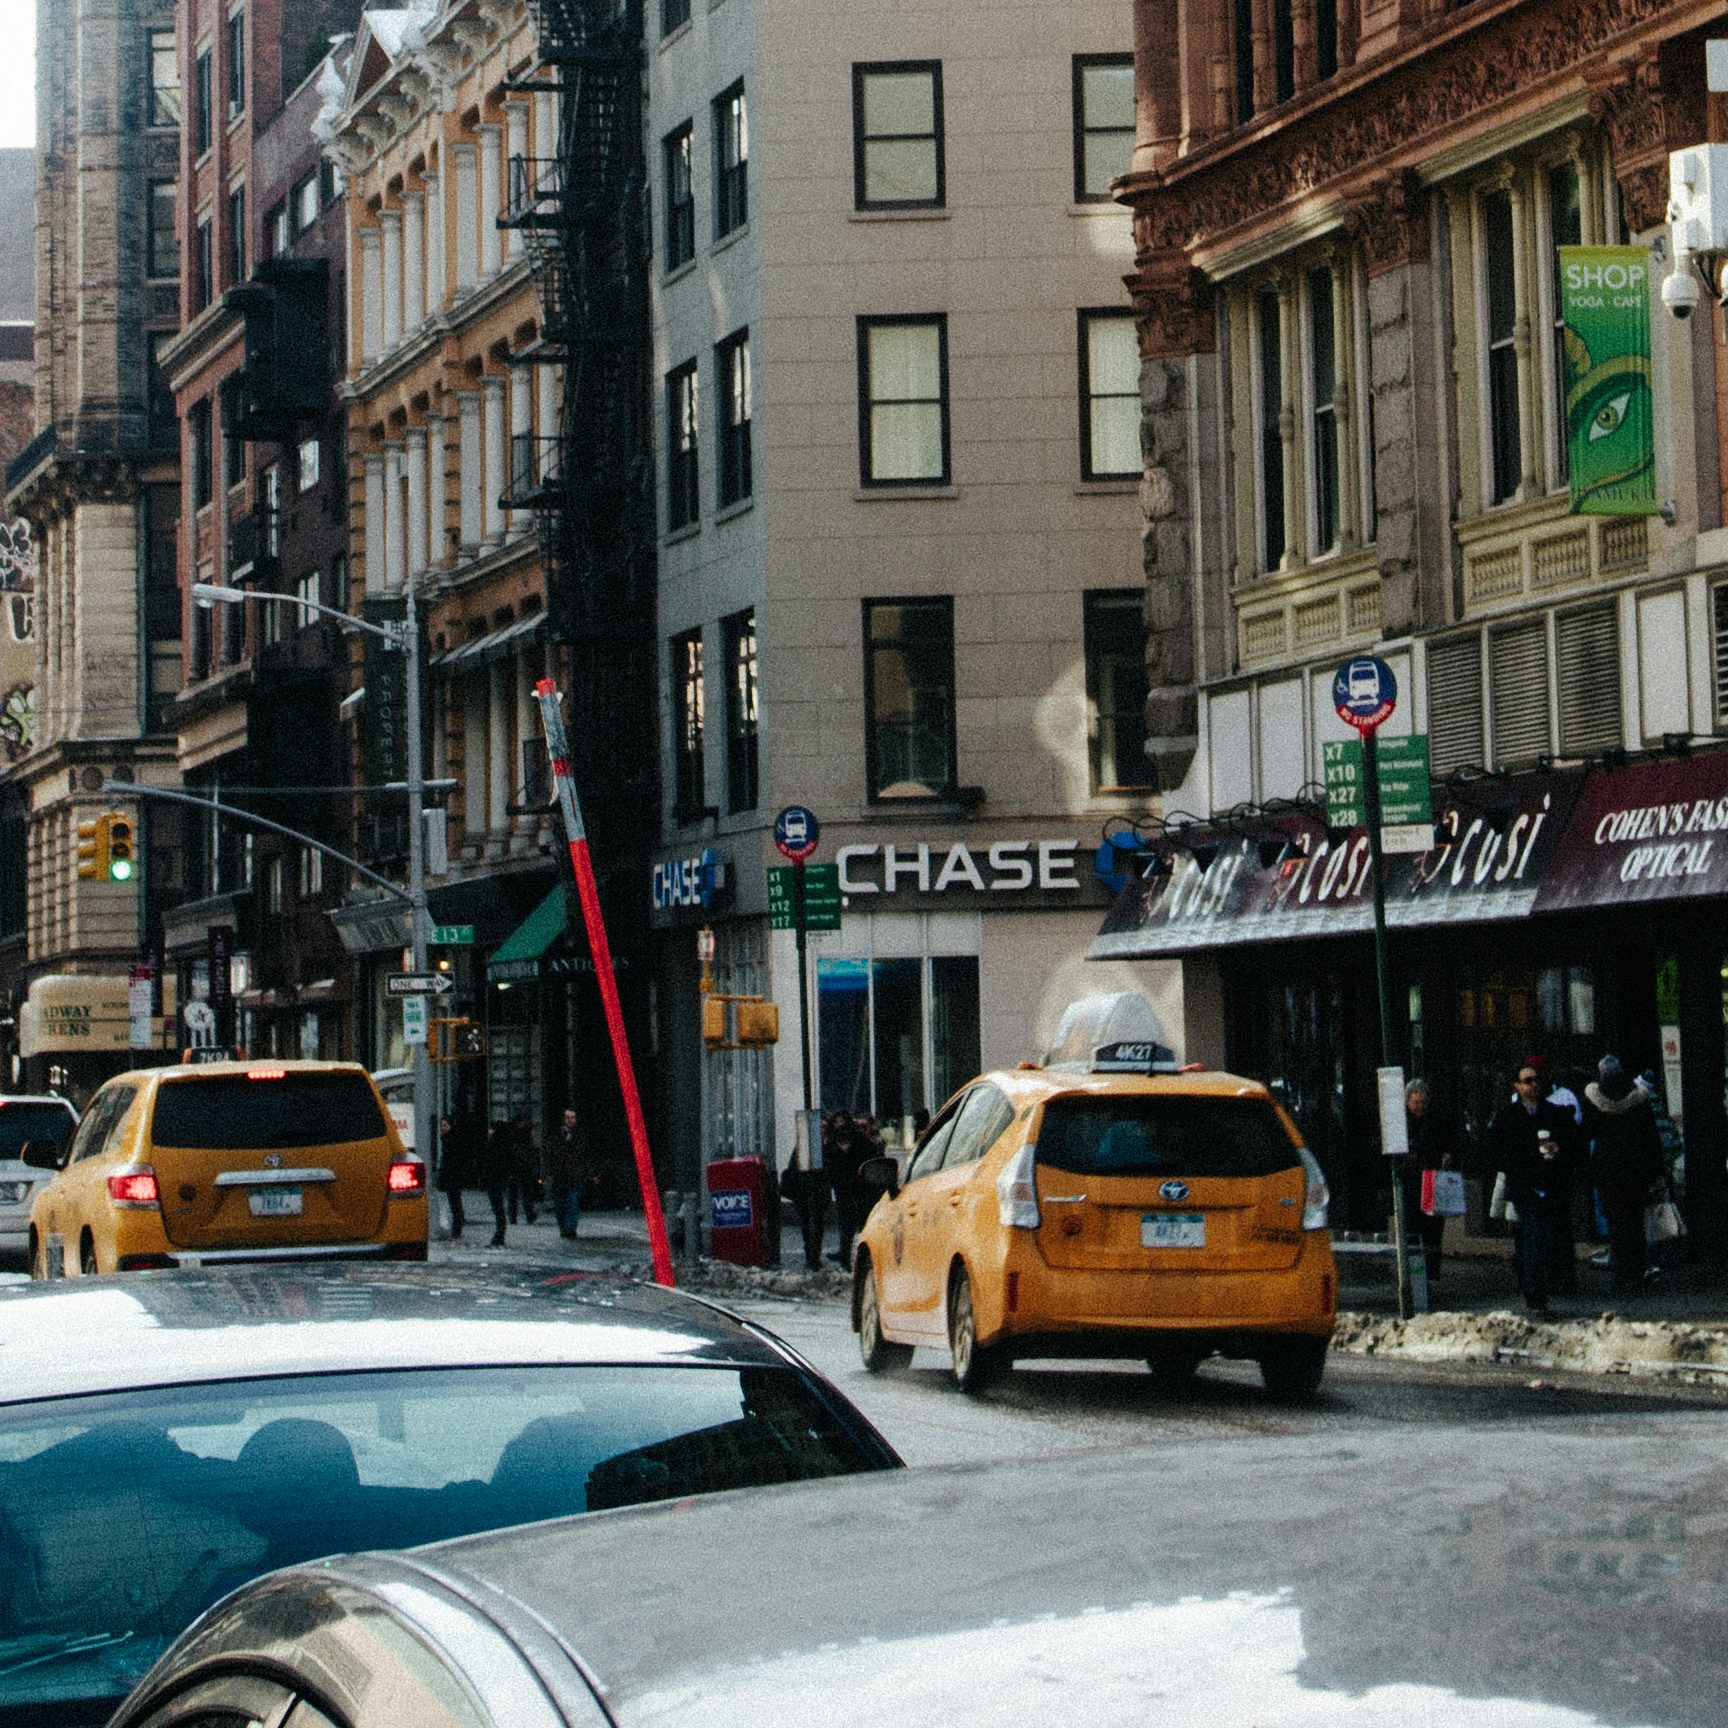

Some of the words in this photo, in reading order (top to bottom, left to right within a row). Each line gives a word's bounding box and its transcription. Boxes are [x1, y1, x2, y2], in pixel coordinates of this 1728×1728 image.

[1566, 264, 1645, 289] SHOP
[1569, 294, 1604, 309] YOGA
[1325, 744, 1343, 761] x7
[1327, 763, 1355, 782] x10
[1329, 787, 1356, 804] x27
[1330, 810, 1358, 828] x28
[1594, 801, 1687, 845] COHEN'S
[836, 839, 1081, 893] CHASE
[1620, 839, 1713, 884] OPTICAL
[653, 858, 700, 909] CHASE
[392, 979, 412, 989] ONE
[1115, 1044, 1153, 1060] 4K27
[713, 1195, 749, 1210] VOICE
